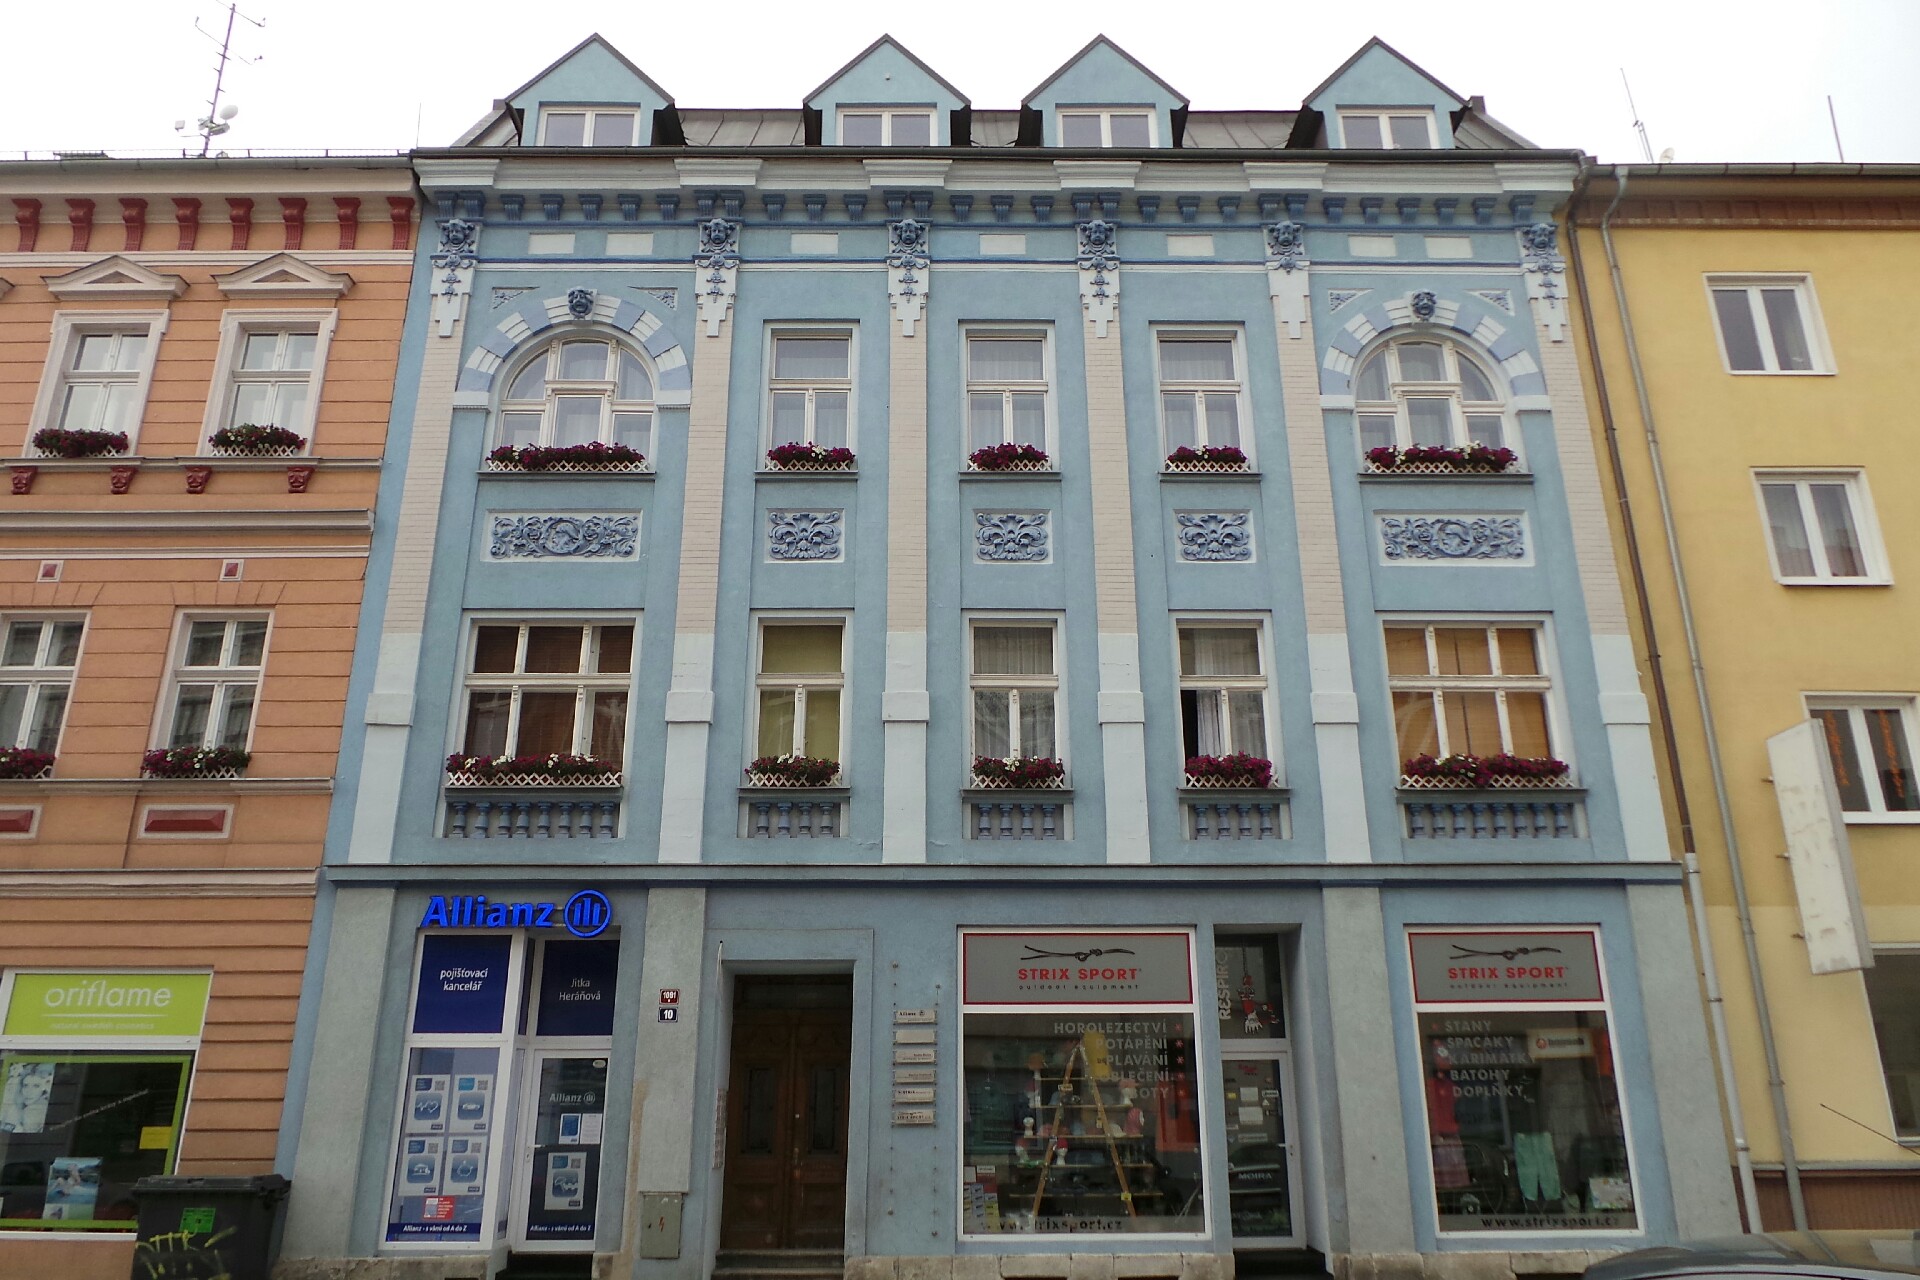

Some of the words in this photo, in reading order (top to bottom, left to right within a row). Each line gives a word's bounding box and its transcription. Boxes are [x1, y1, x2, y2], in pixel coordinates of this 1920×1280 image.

[420, 895, 554, 928] Allianz
[439, 967, 489, 980] pojišťovací
[1018, 968, 1069, 980] STRIX
[1078, 968, 1138, 980] SPORT
[1448, 967, 1498, 979] STRIX
[1506, 966, 1564, 979] SPORT
[443, 981, 482, 991] kancelář
[571, 977, 590, 988] Jitka
[1074, 983, 1138, 991] equipment
[1215, 949, 1232, 1020] RESPIRO
[46, 980, 172, 1007] oriflame
[559, 991, 601, 1001] Heráňová
[663, 1009, 673, 1020] 10
[1054, 1018, 1168, 1034] HOROLEZECTVÍ
[1444, 1020, 1491, 1032] STANY
[1095, 1035, 1168, 1050] POTÁPĚNÍ
[1106, 1051, 1168, 1066] PLAVÁNÍ
[1450, 1069, 1510, 1081] BATOHY
[1453, 1082, 1523, 1097] DOPLŇKY
[549, 1093, 582, 1102] Allianz
